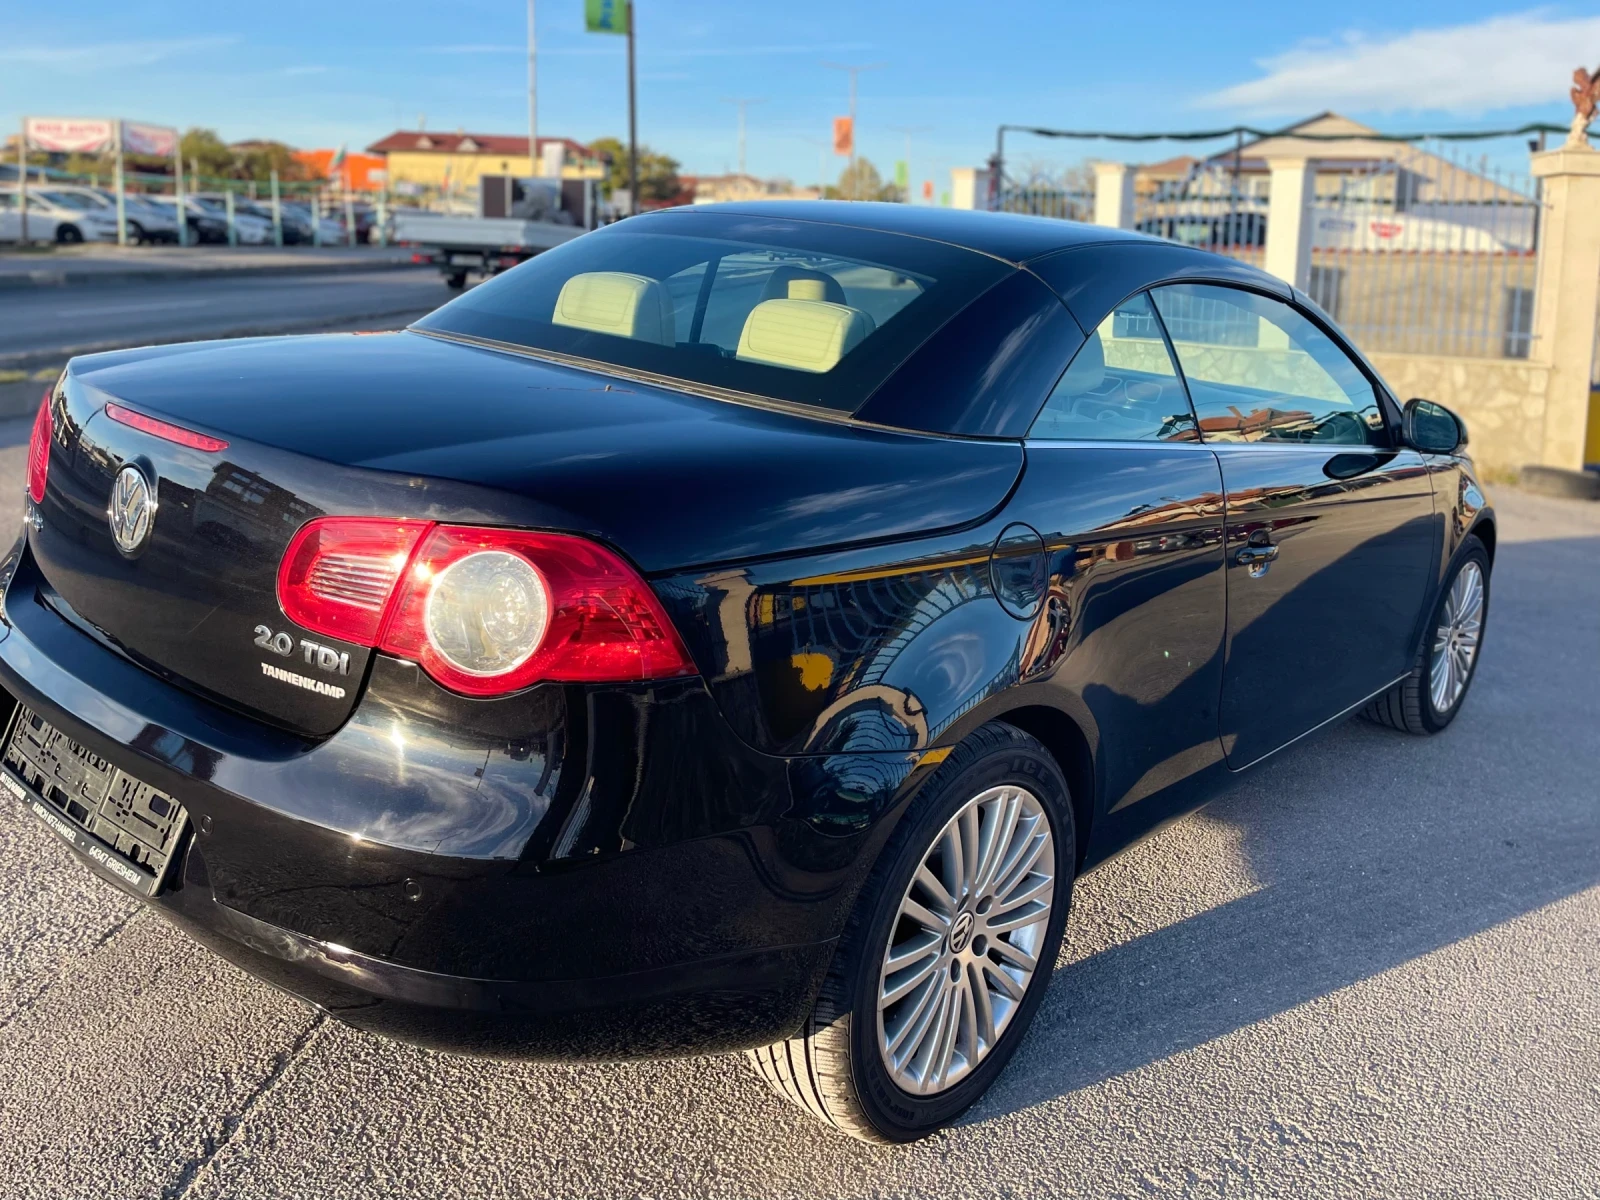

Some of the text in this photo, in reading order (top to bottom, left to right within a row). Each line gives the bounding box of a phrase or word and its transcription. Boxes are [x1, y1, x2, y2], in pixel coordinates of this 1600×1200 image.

[299, 639, 350, 675] TDI
[260, 662, 346, 699] TANNENKAMP
[106, 857, 142, 885] GRIESHEIM
